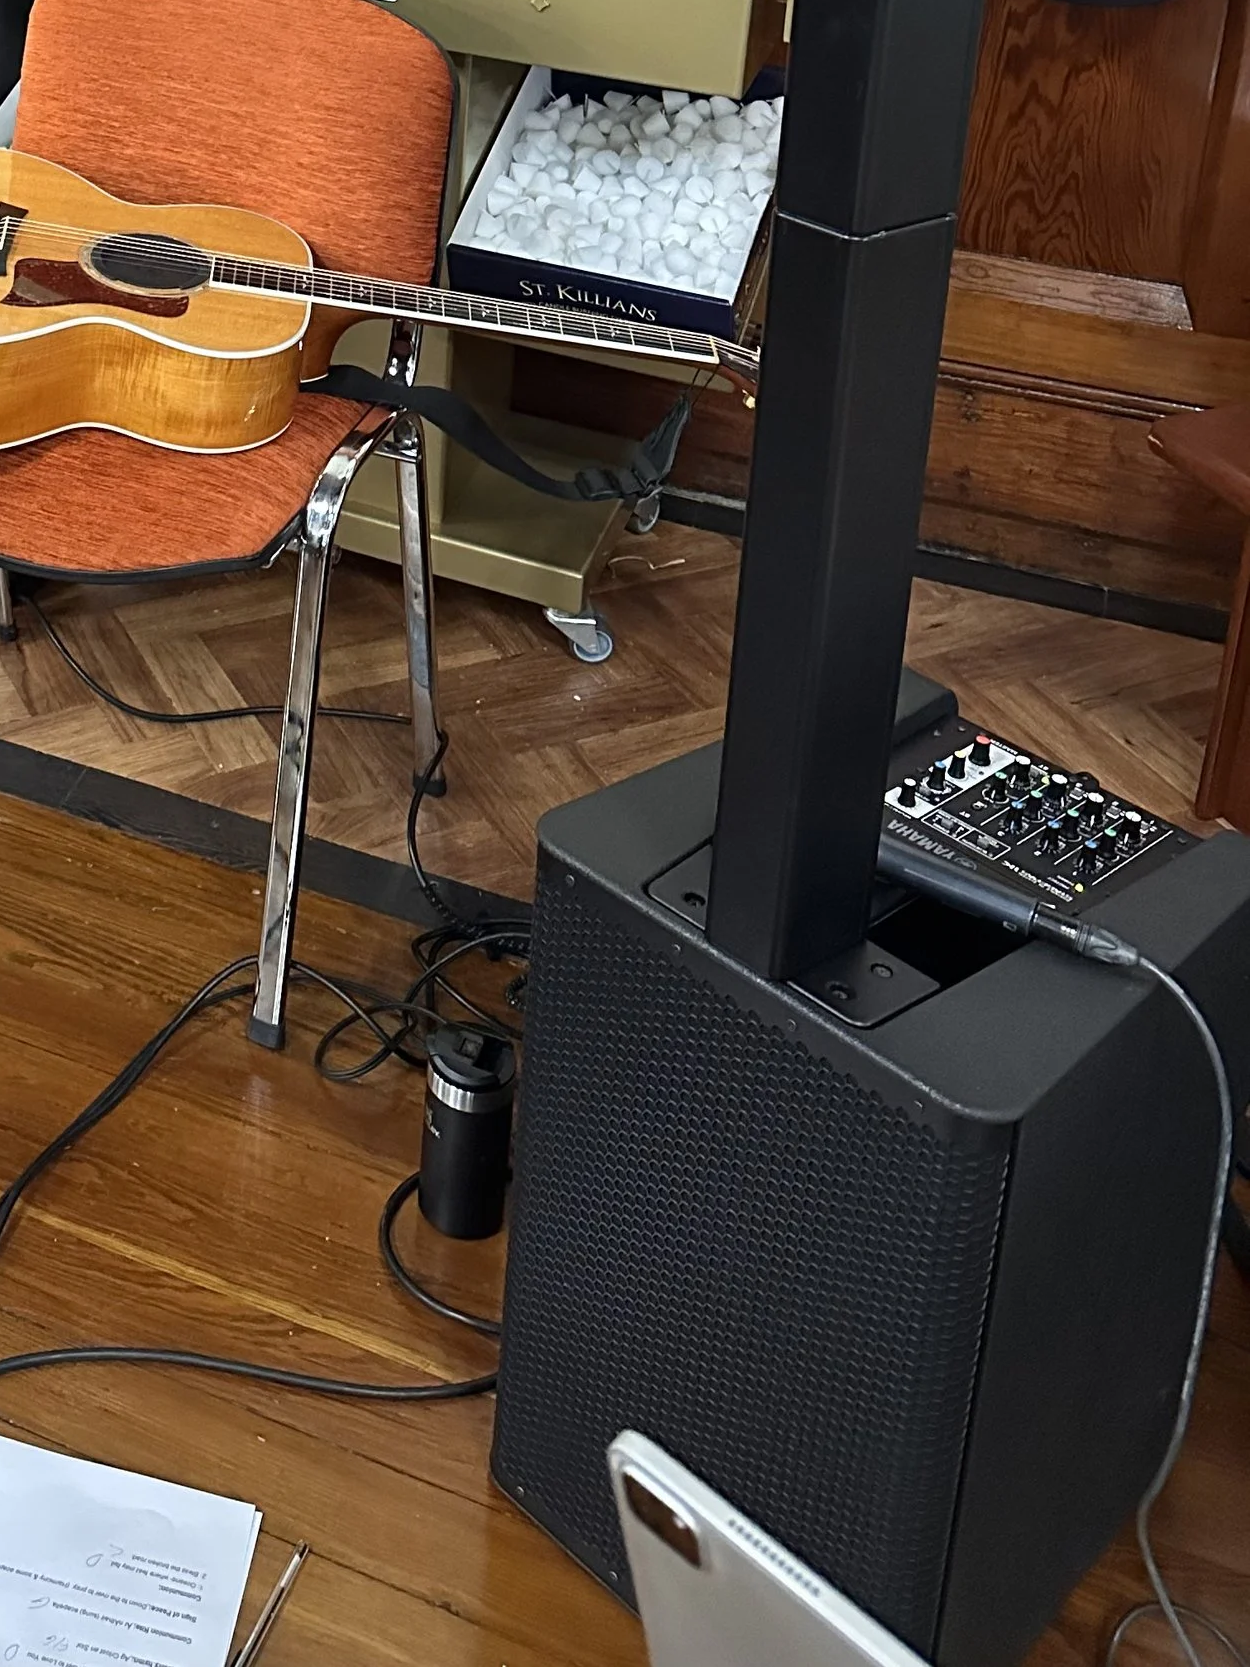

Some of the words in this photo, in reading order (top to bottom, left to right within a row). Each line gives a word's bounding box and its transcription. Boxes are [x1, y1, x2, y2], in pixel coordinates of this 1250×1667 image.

[519, 280, 550, 296] ST.
[556, 284, 657, 321] KILLIANS
[887, 818, 956, 862] YAMAHA
[121, 1562, 136, 1571] may
[147, 1558, 169, 1569] broken
[169, 1564, 180, 1572] the
[15, 1568, 32, 1577] some
[87, 1587, 94, 1595] to
[94, 1589, 109, 1599] river
[109, 1594, 120, 1602] the
[128, 1598, 147, 1609] Down
[78, 1607, 100, 1620] (sung)
[172, 1610, 180, 1618] of
[180, 1612, 197, 1623] Sign
[149, 1627, 192, 1644] Communion
[26, 1651, 39, 1660] You
[40, 1655, 56, 1665] Love
